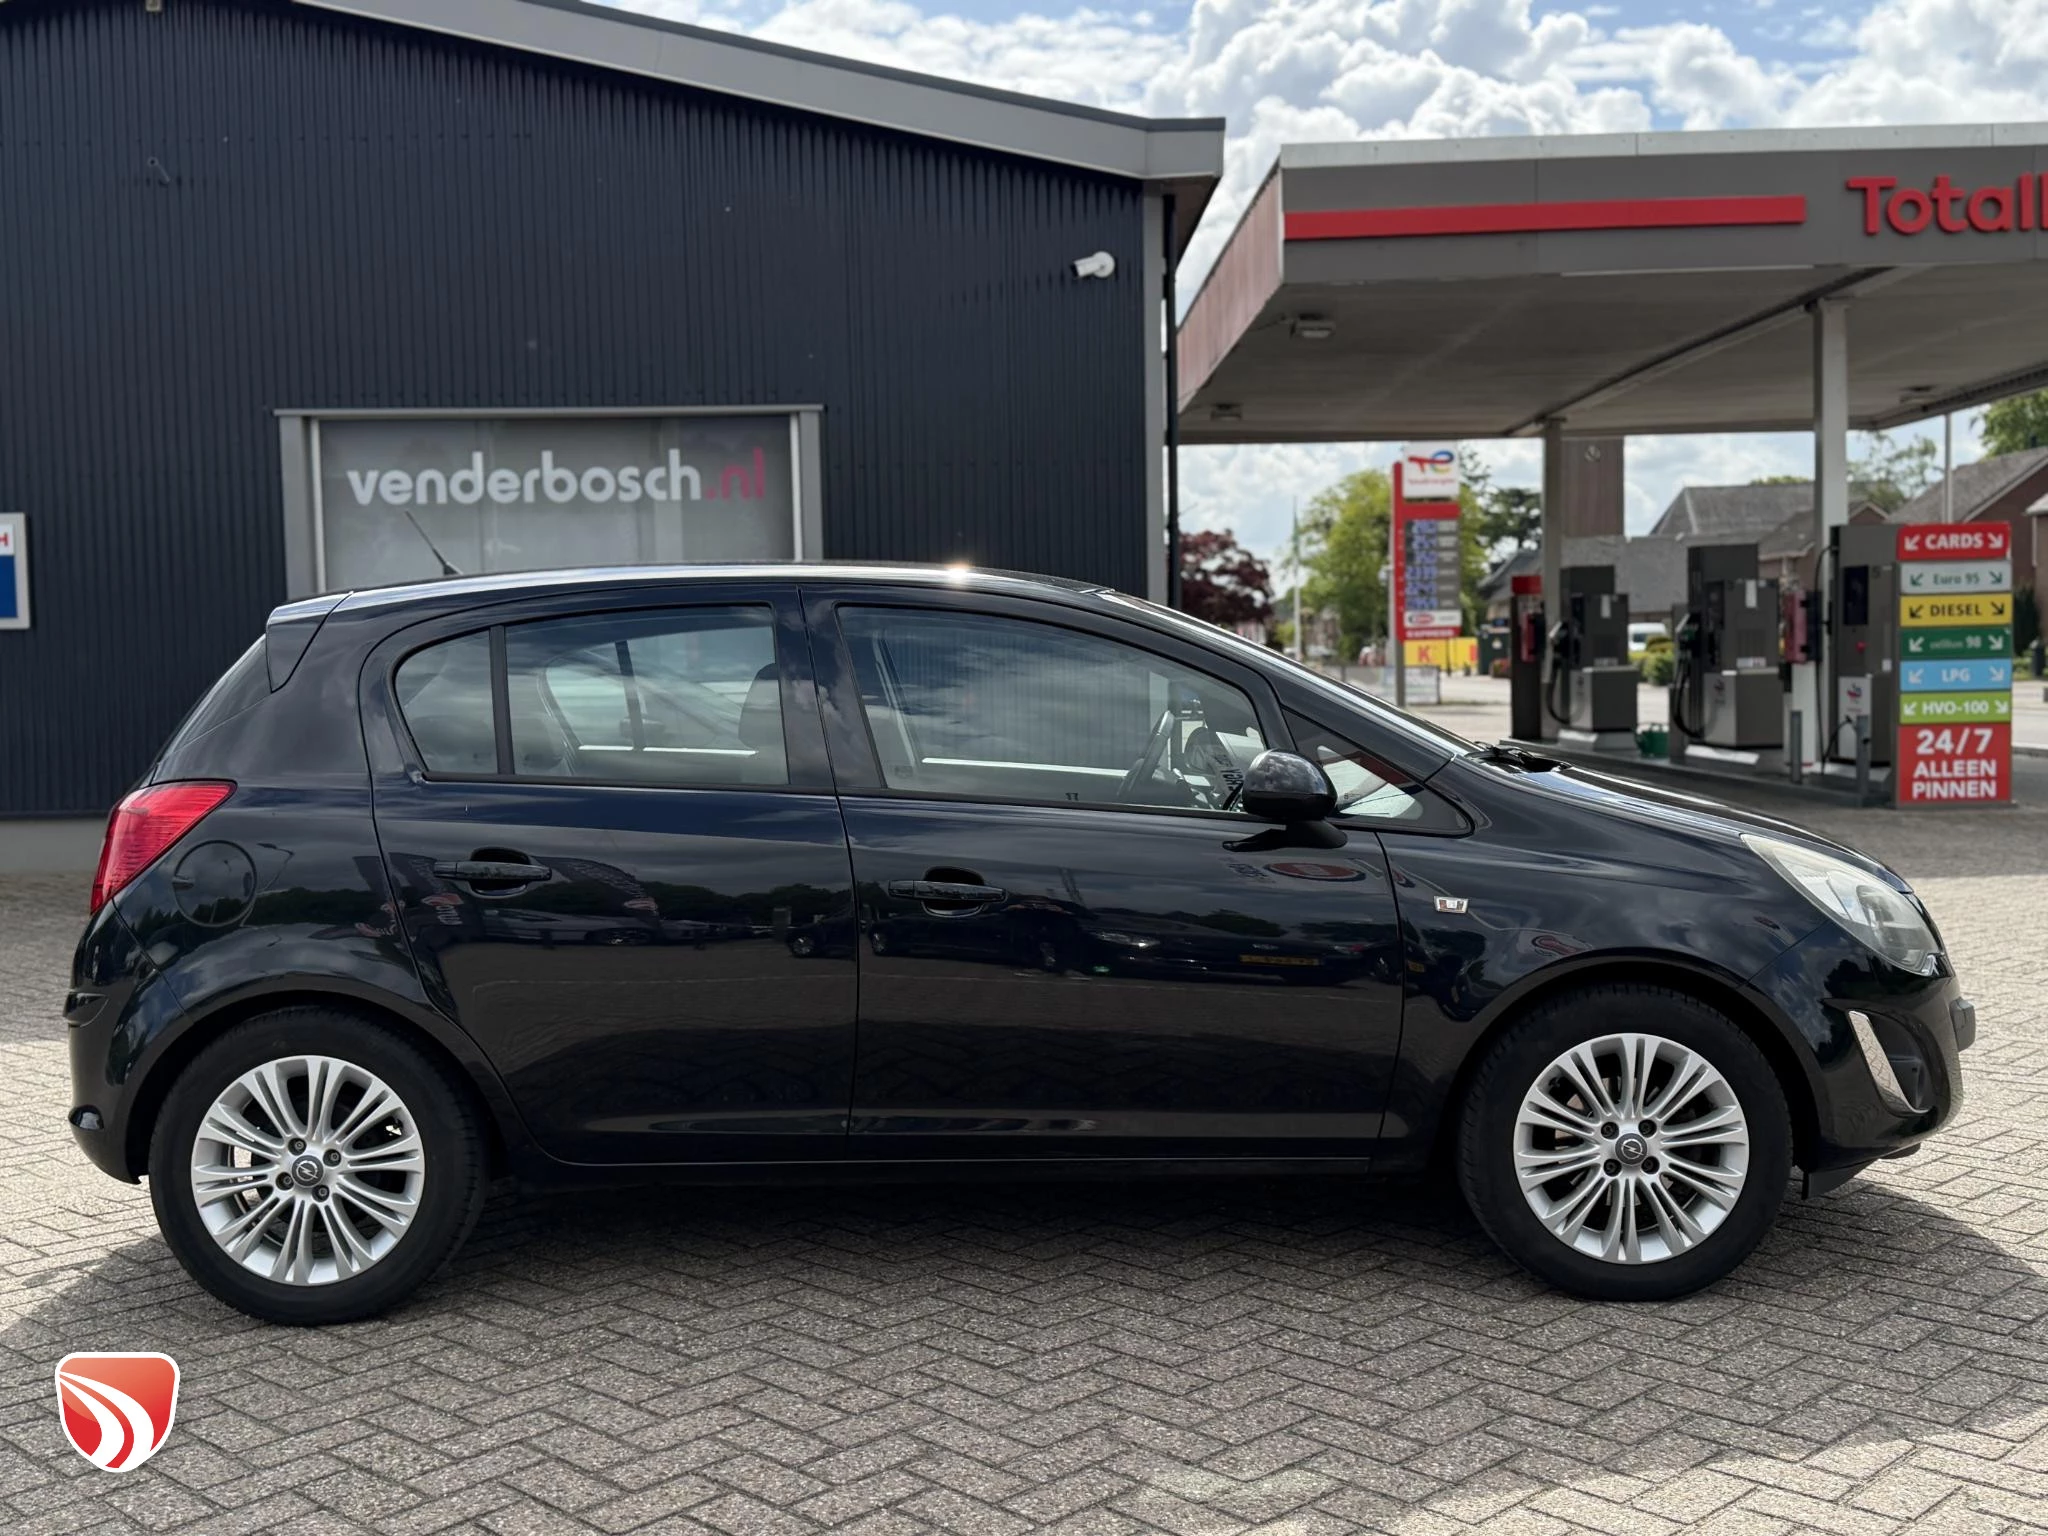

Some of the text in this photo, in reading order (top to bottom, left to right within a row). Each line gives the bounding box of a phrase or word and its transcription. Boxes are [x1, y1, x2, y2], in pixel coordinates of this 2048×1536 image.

[1846, 171, 2048, 235] Total
[347, 447, 765, 506] venderbosch.nl
[1925, 533, 1983, 550] CARDS
[1933, 572, 1980, 585] Euro 95
[1930, 603, 1982, 617] DIESEL
[1942, 668, 1971, 682] LPG
[1922, 701, 1989, 715] HVO-100
[1916, 728, 1993, 755] 24/7
[1913, 760, 1997, 778] ALLEEN
[1912, 780, 1997, 799] PINNEN
